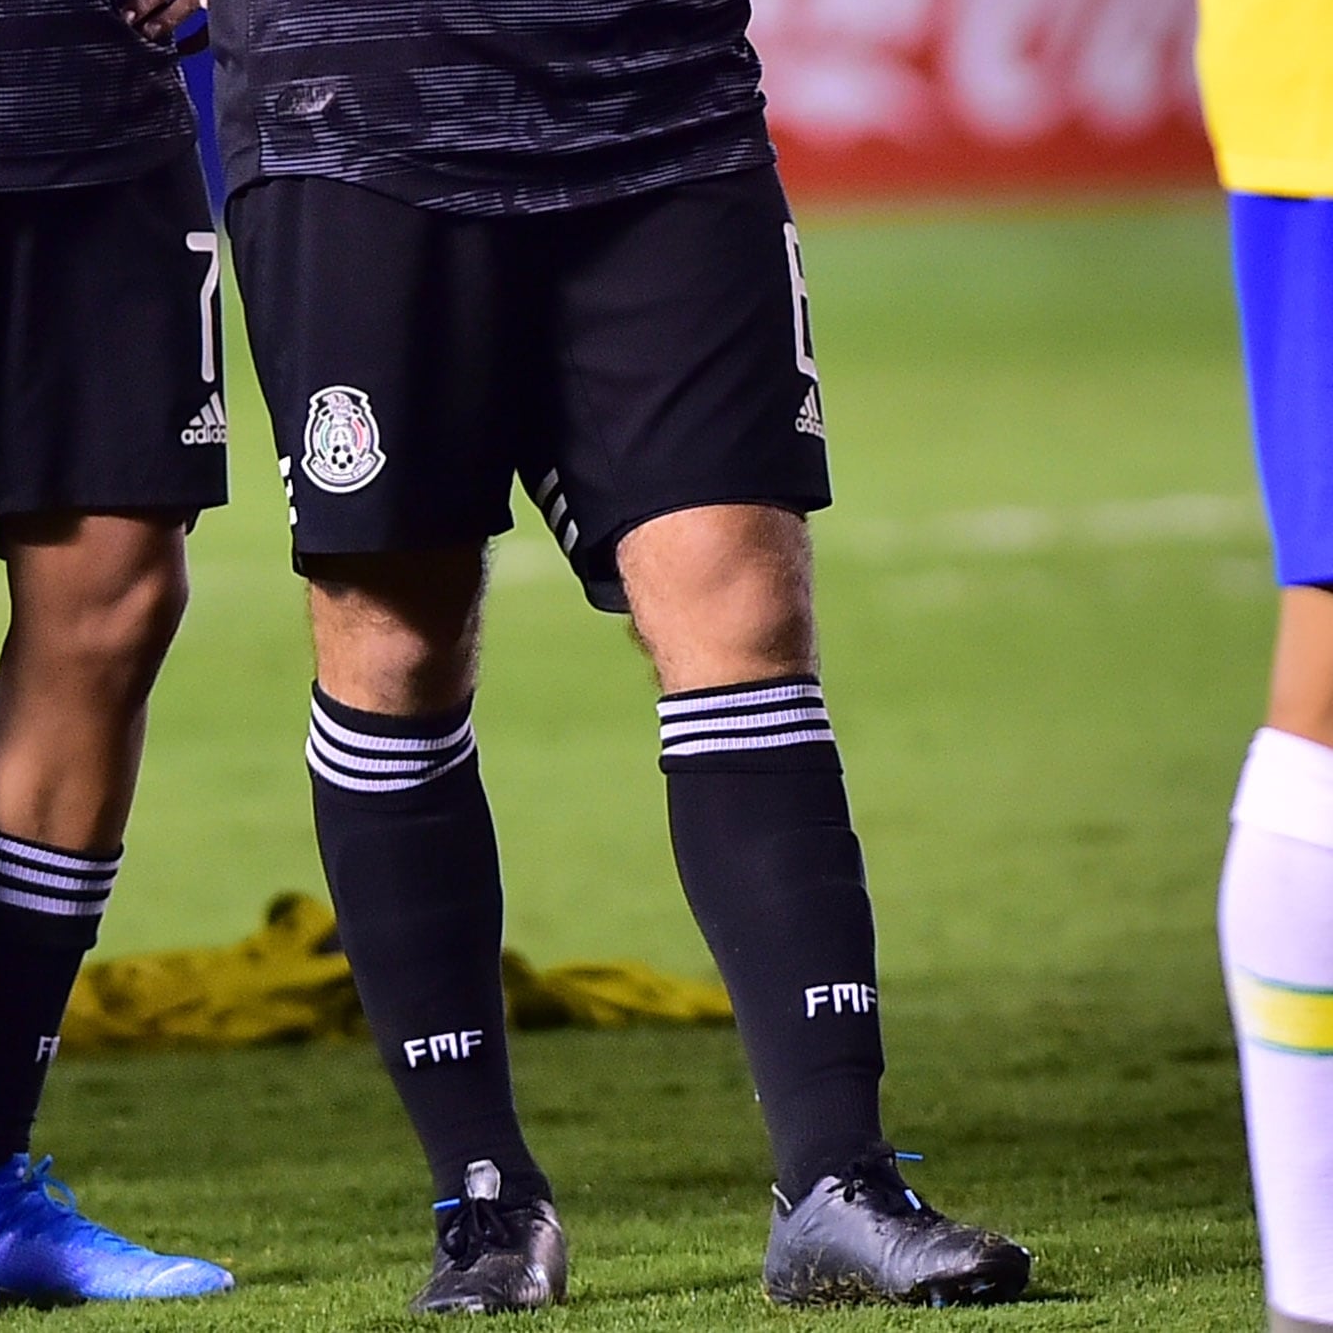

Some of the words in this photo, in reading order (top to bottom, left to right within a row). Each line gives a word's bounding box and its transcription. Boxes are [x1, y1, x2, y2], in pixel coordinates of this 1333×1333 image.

[185, 232, 219, 382] 7
[805, 981, 878, 1018] FMF
[403, 1029, 483, 1068] FMF
